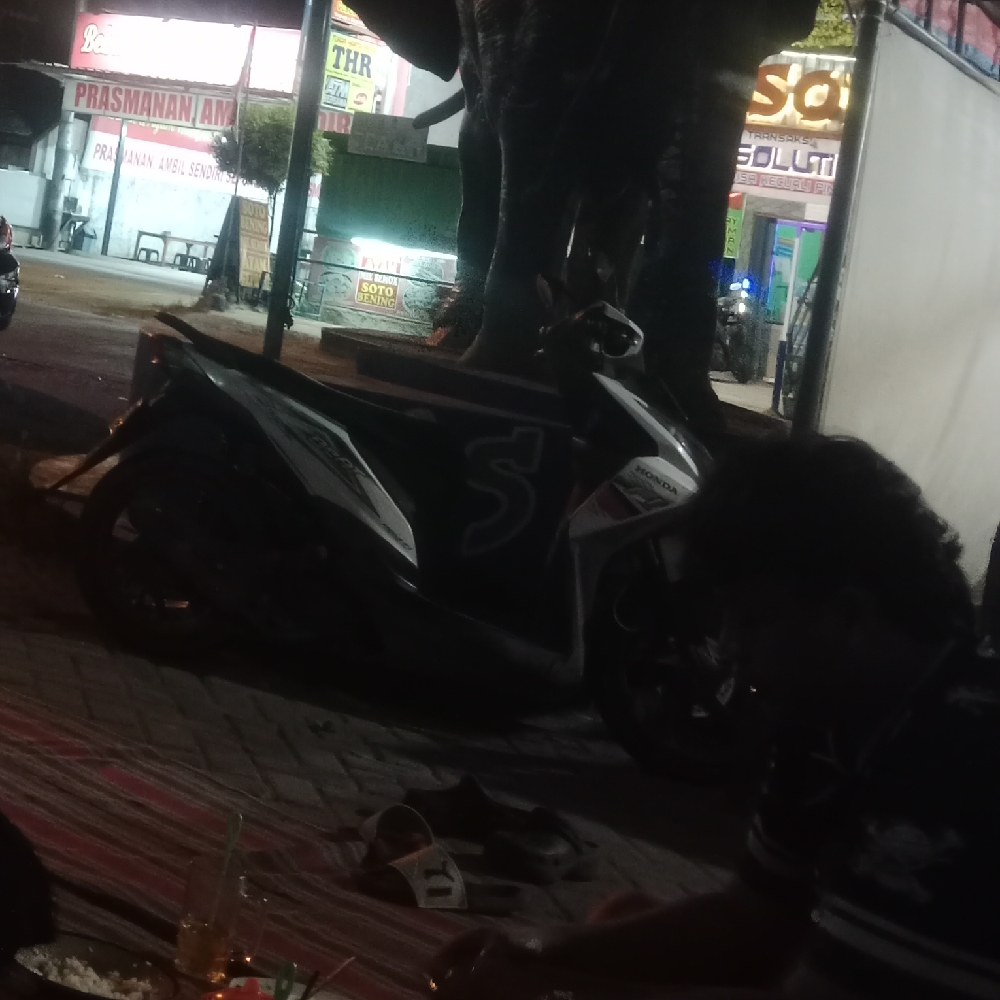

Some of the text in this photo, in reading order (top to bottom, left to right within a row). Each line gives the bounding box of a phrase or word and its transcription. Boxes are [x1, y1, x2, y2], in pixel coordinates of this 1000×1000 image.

[332, 44, 372, 79] THR
[358, 292, 395, 308] BENING
[361, 282, 394, 297] SOTO
[634, 464, 679, 496] HONDA
